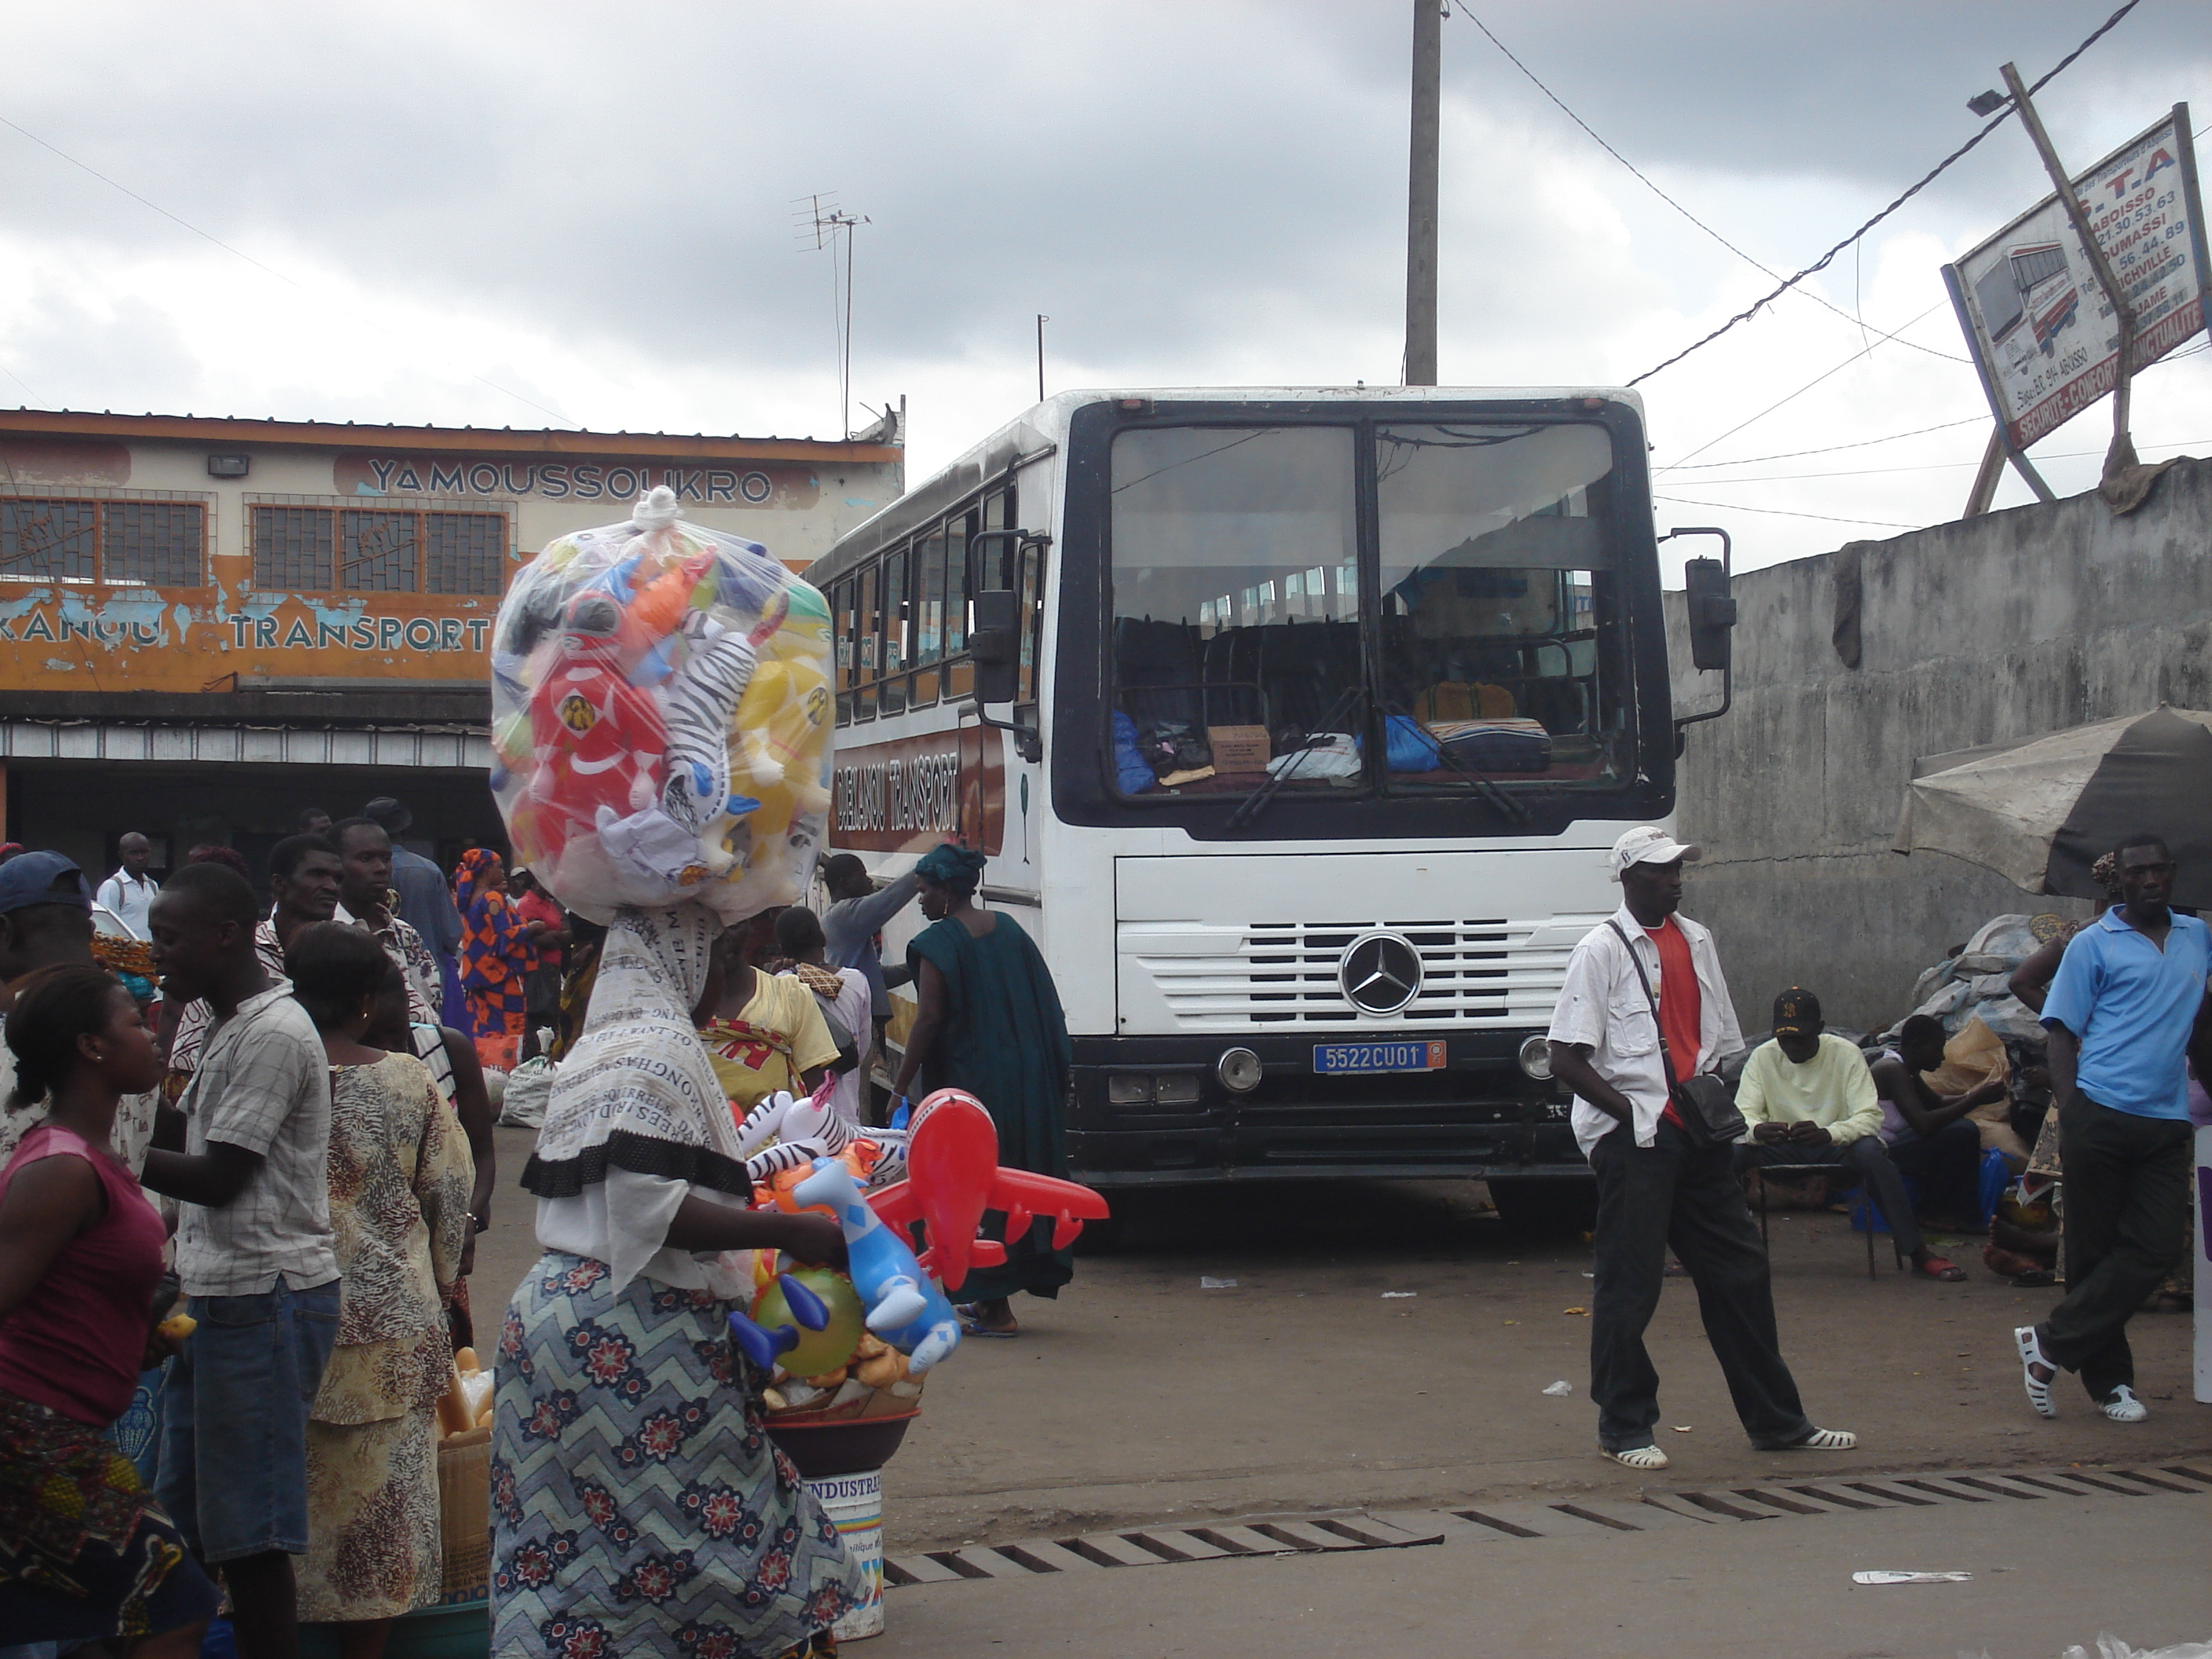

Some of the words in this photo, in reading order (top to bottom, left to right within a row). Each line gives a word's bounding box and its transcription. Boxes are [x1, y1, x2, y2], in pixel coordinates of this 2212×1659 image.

[229, 613, 491, 654] TRANSPORT
[889, 752, 958, 833] TRANSPORT
[1326, 1046, 1417, 1069] 5522CU01
